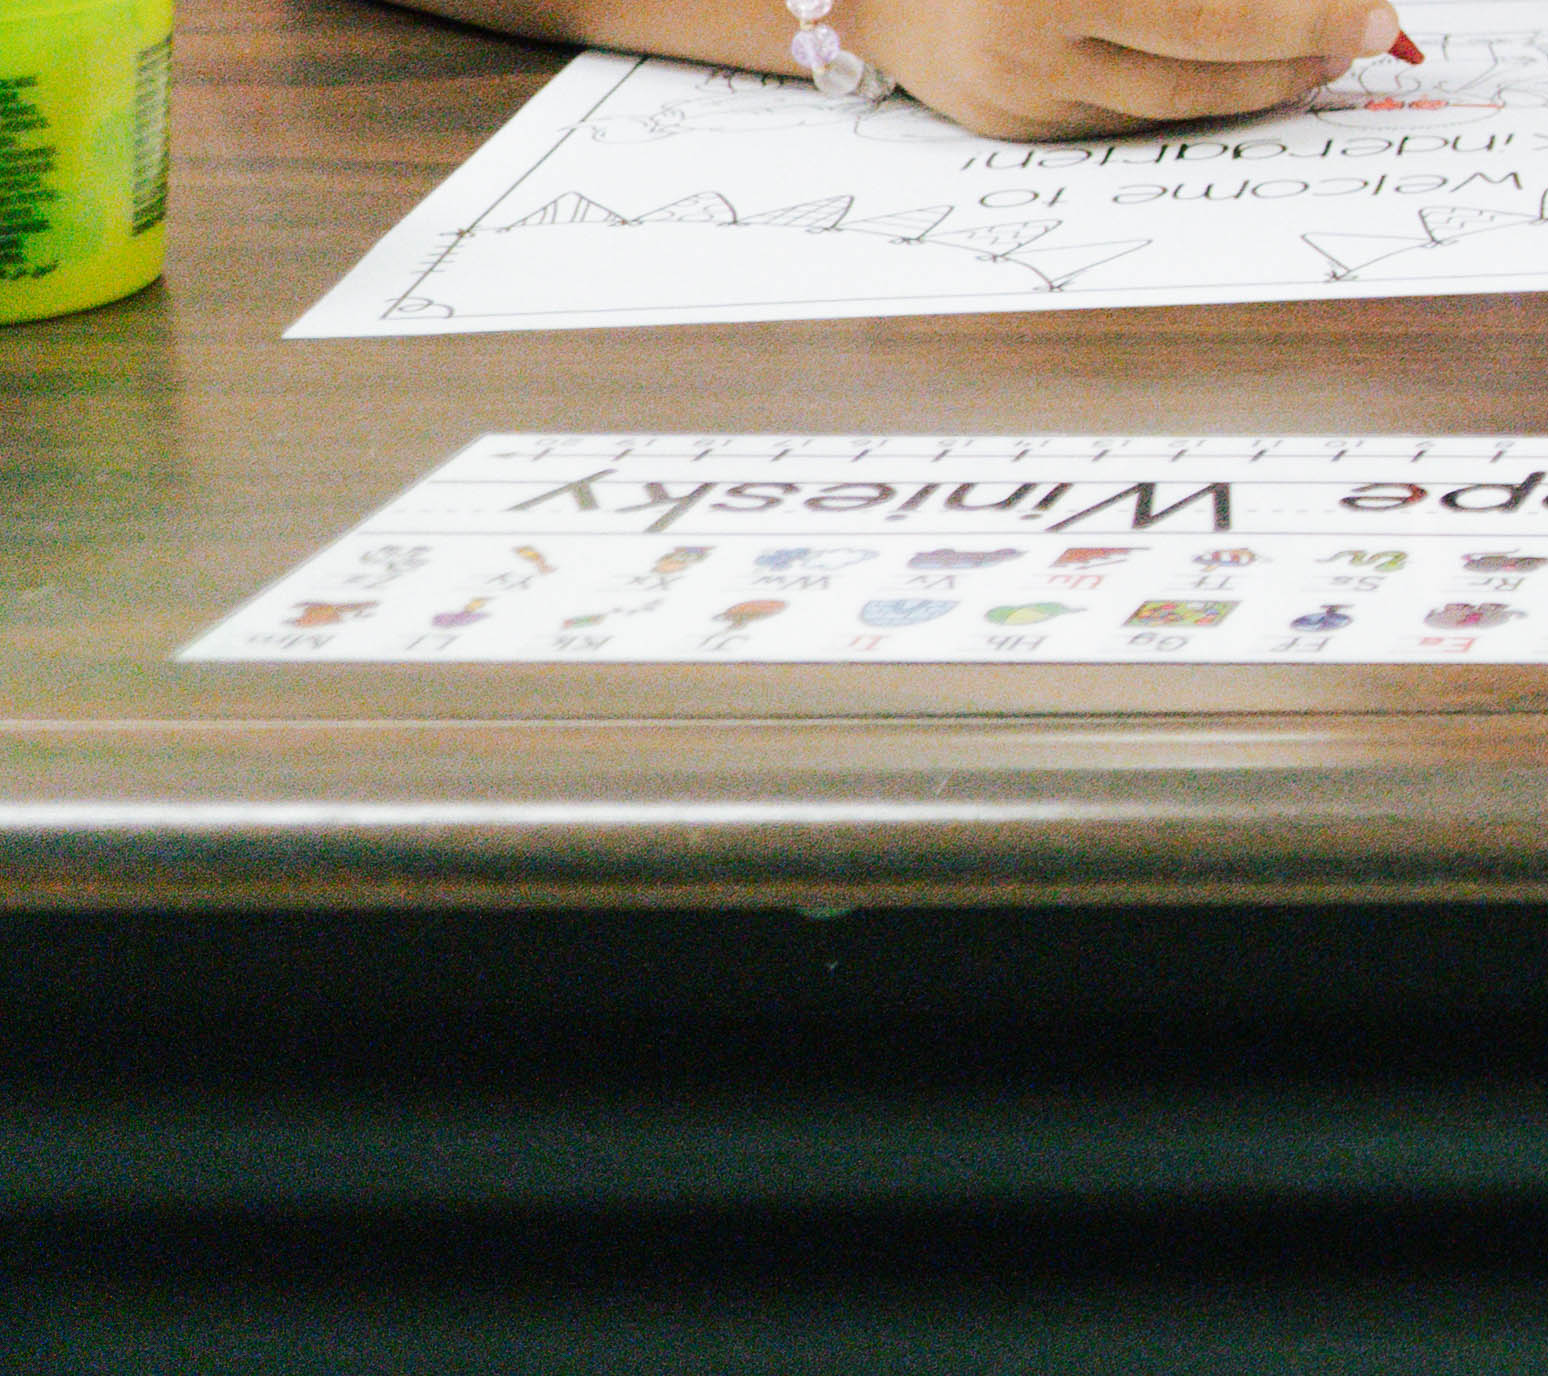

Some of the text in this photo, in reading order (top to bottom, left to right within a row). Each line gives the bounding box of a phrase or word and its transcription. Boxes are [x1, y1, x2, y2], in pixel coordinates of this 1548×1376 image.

[978, 187, 1066, 209] to
[506, 468, 1232, 534] Winiesky
[486, 571, 533, 590] Yy
[628, 576, 683, 591] Xx
[752, 576, 831, 591] Ww
[905, 575, 956, 590] Vv
[1047, 574, 1104, 590] Uu
[1329, 576, 1386, 592] Ss
[1468, 577, 1525, 592] Rr
[245, 634, 335, 650] Mm
[406, 635, 460, 651] Ll
[553, 635, 614, 651] Kk
[987, 635, 1047, 651] Hh
[1128, 632, 1189, 652] Gg
